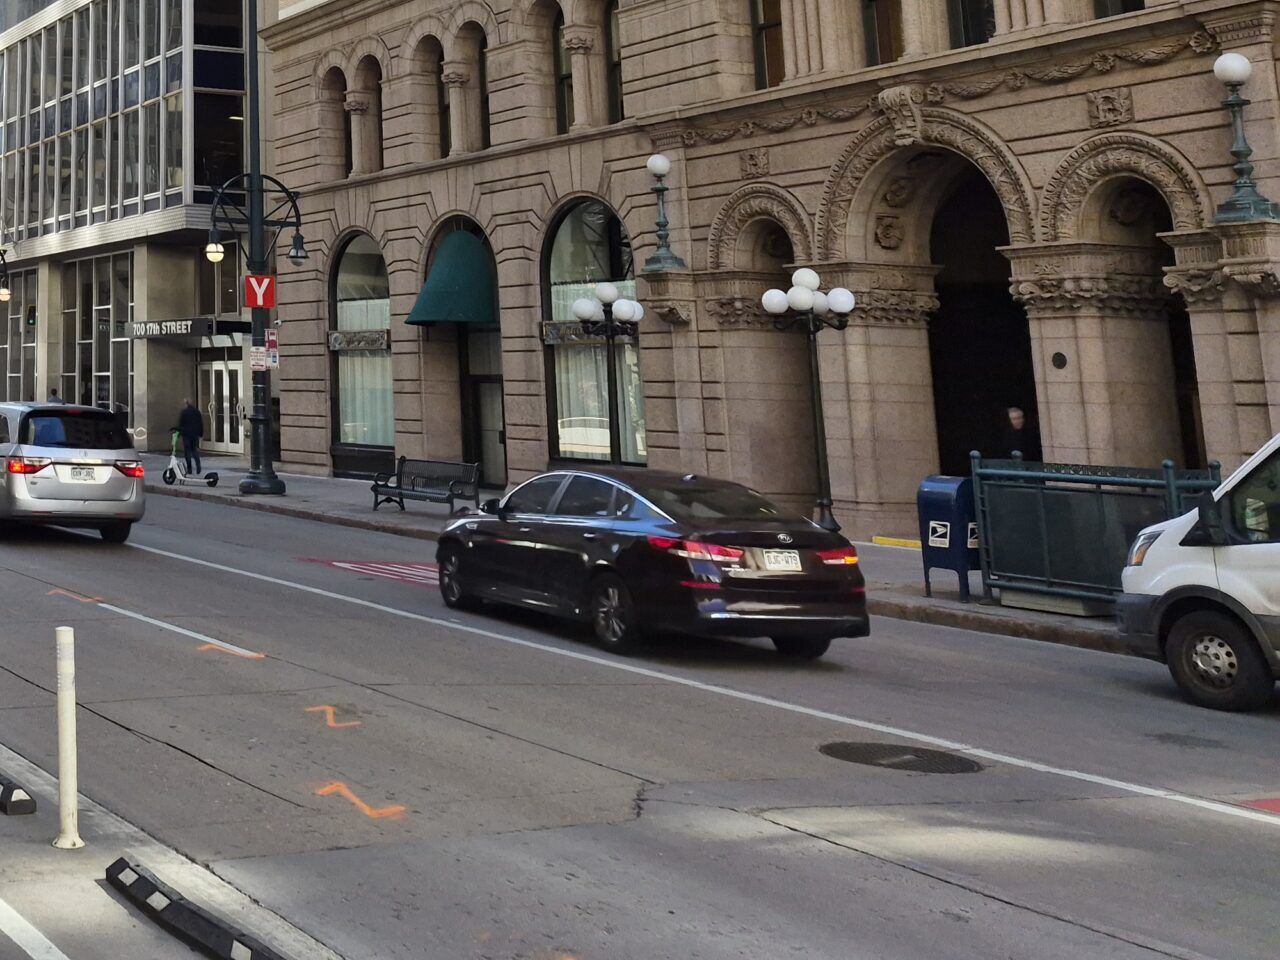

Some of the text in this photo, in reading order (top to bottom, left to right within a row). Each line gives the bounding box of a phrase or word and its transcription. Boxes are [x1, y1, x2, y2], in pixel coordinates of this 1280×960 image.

[249, 277, 271, 306] Y
[132, 320, 193, 336] 700 17th STREET
